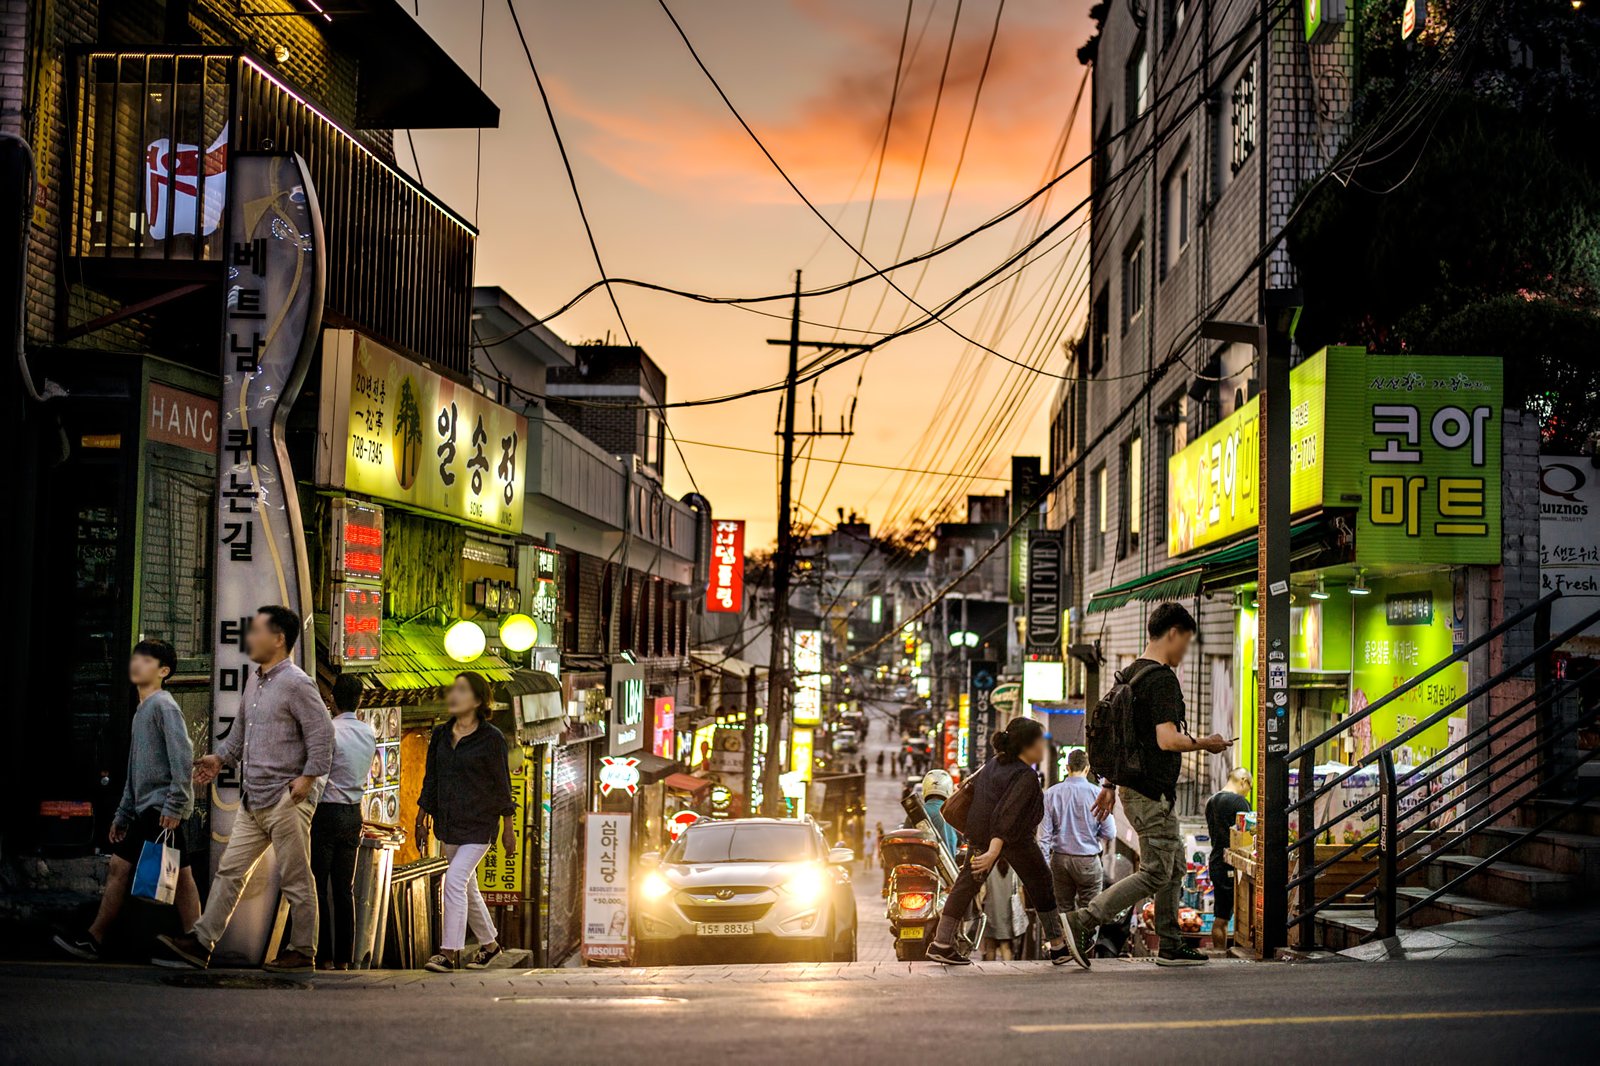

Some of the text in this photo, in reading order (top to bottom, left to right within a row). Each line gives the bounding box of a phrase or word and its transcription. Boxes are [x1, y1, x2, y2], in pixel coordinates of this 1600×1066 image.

[230, 238, 266, 372] 베트남
[437, 401, 518, 506] 일송정
[1369, 404, 1492, 466] 코아
[1369, 475, 1488, 537] 마트
[1032, 548, 1057, 636] HACIENDA
[1555, 573, 1598, 591] Fresh
[600, 820, 618, 883] 심야식당
[723, 924, 749, 934] 8836
